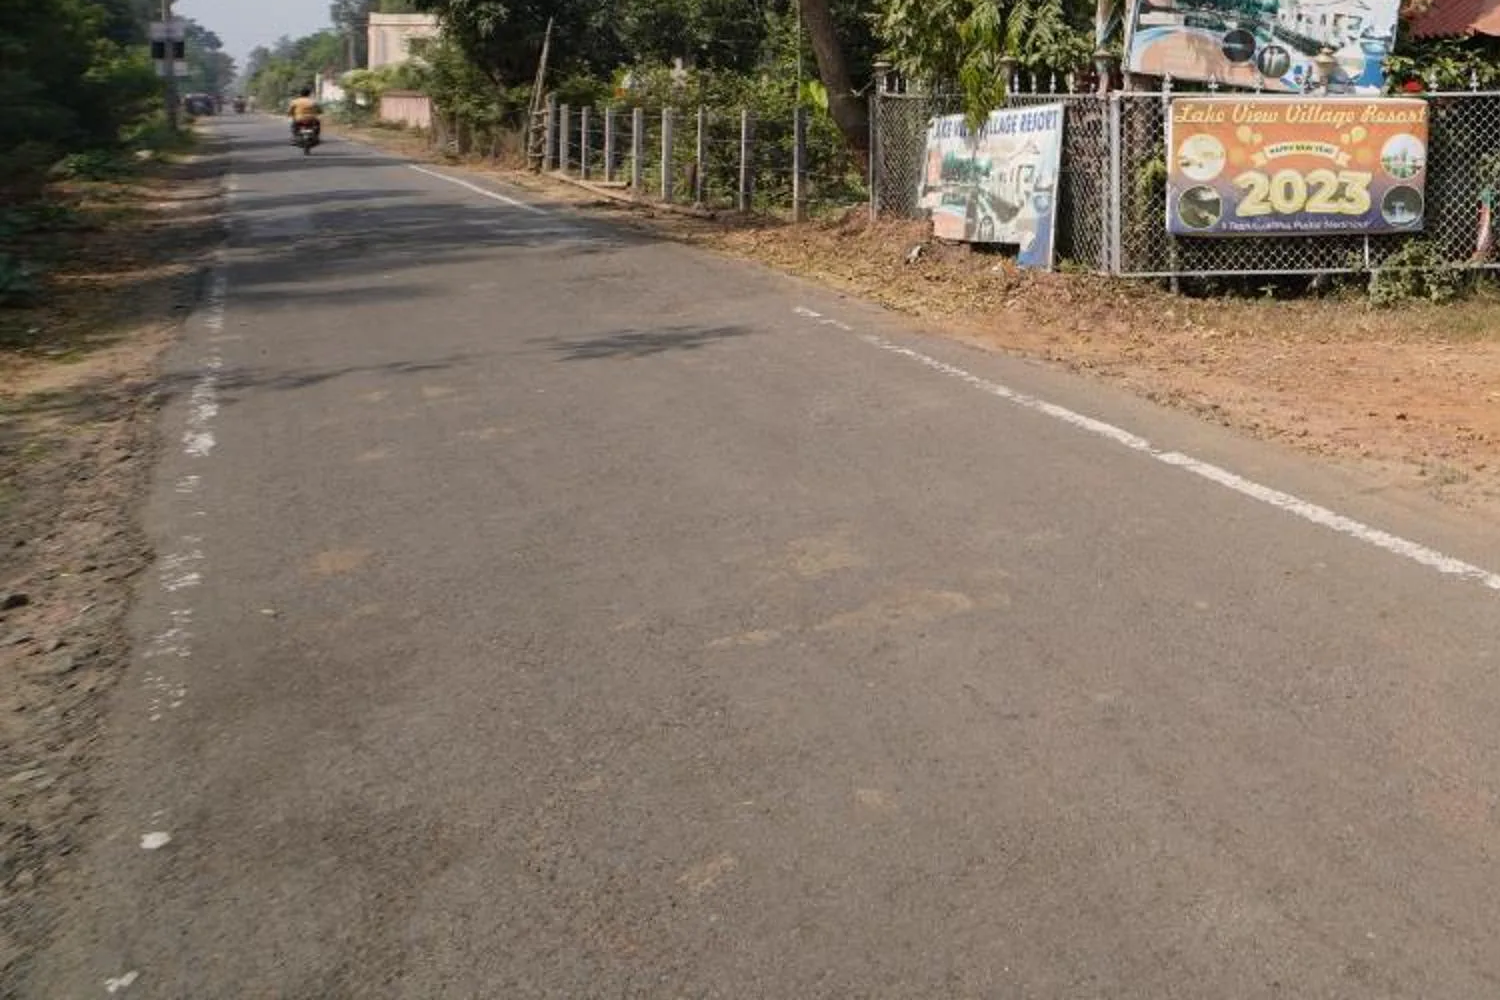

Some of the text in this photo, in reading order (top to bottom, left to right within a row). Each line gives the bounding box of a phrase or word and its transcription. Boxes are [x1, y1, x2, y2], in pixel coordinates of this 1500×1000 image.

[1020, 110, 1058, 133] RESORT
[1174, 104, 1426, 128] Lake View Village Resort
[1233, 168, 1373, 217] 2023
